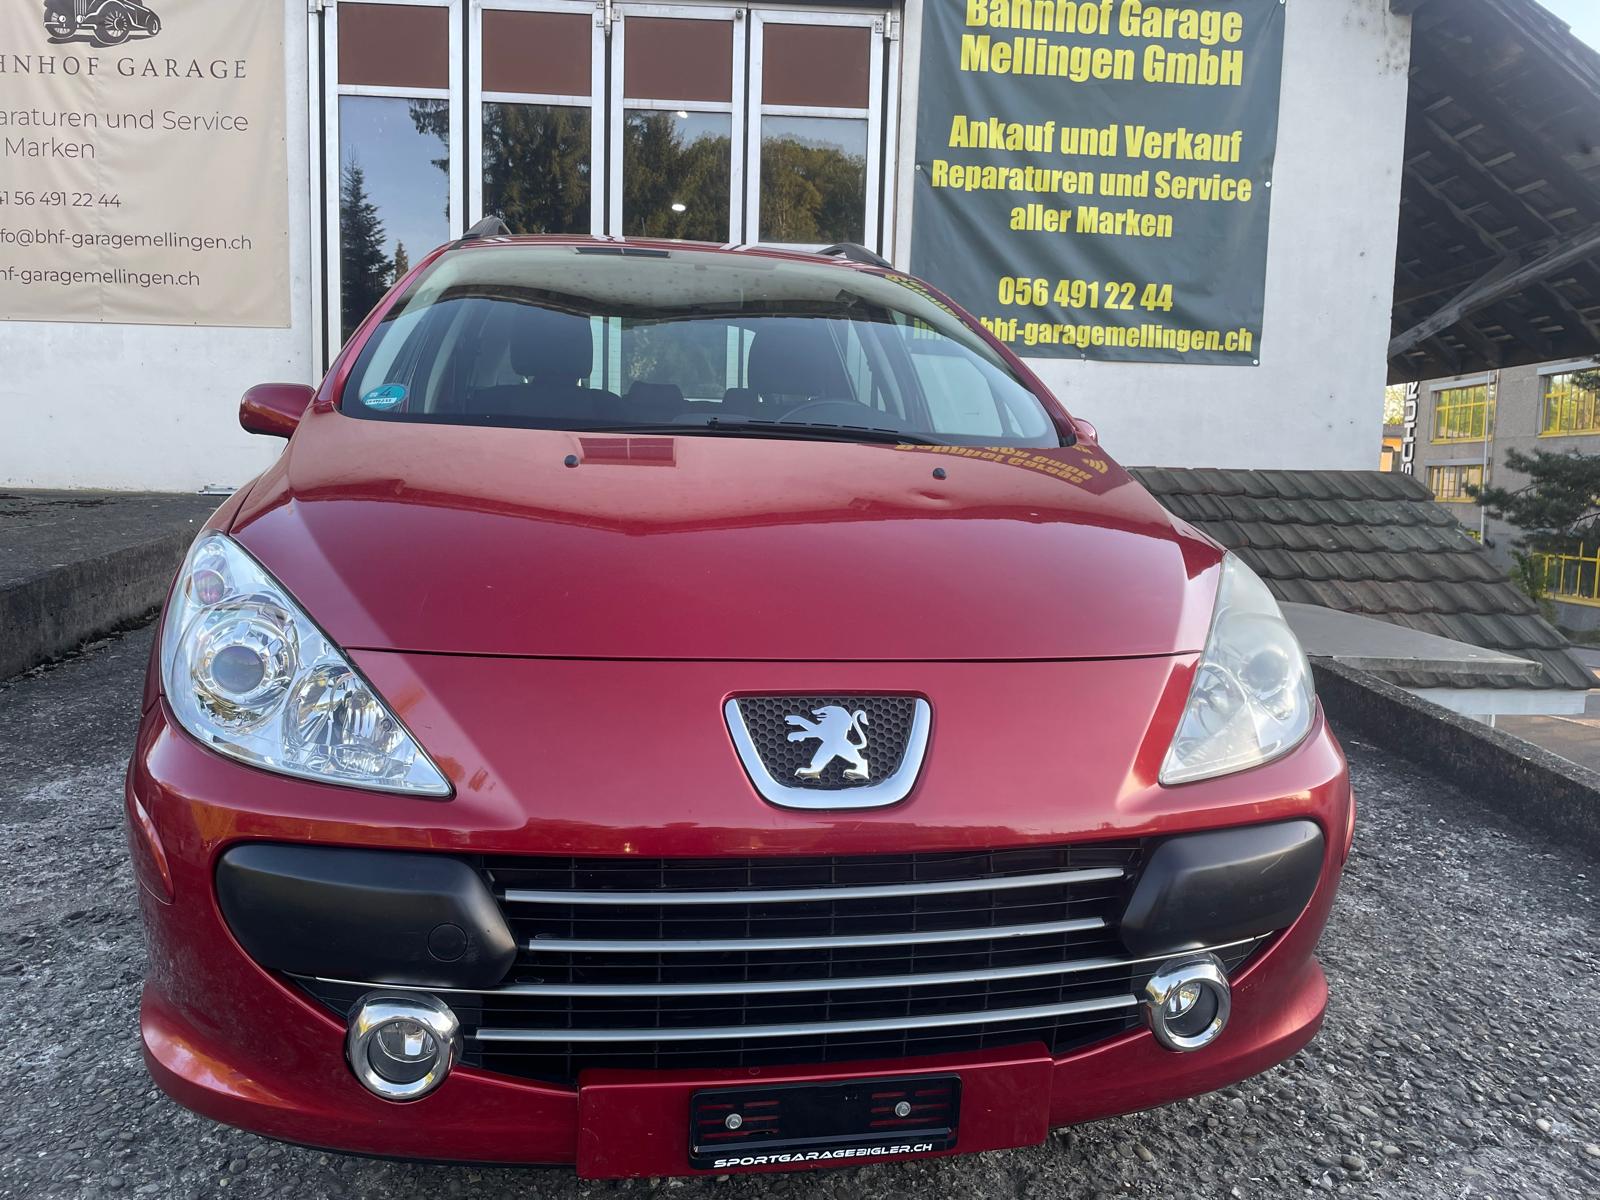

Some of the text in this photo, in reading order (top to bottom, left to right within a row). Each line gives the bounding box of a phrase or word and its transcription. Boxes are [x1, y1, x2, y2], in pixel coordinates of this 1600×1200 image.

[966, 0, 1243, 45] Bahnhof Garage
[117, 57, 247, 79] GARAGE
[960, 34, 1243, 86] Mellingen GmbH
[106, 109, 154, 130] und
[162, 110, 249, 132] Service
[5, 136, 95, 159] Marken
[949, 115, 1242, 163] Ankauf und Verkauf
[931, 159, 1252, 202] Reparaturen und Service
[14, 191, 35, 206] 56
[40, 191, 67, 206] 491
[72, 192, 93, 208] 22
[98, 193, 121, 208] 44
[1010, 203, 1173, 238] aller Marken
[998, 277, 1048, 307] 056
[1053, 279, 1099, 309] 491
[1104, 281, 1136, 311] 22
[1140, 283, 1173, 312] 44
[714, 1143, 933, 1168] SPORTGARAGEBIGLER.CH
